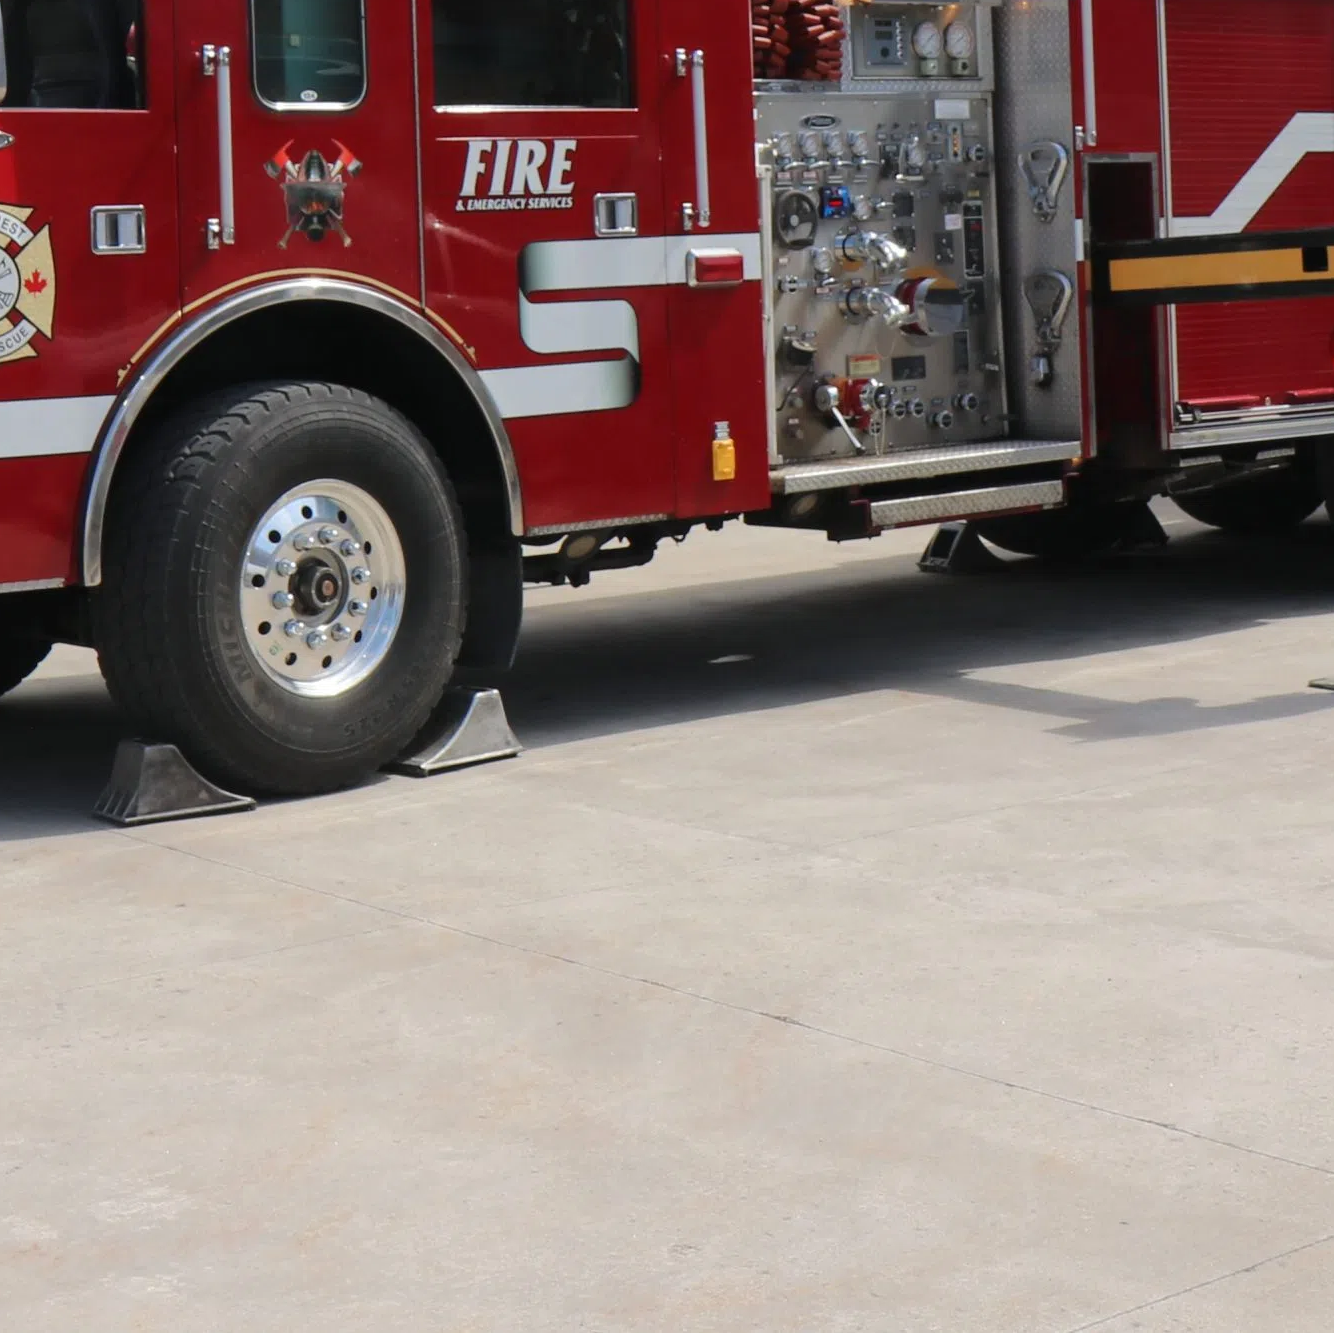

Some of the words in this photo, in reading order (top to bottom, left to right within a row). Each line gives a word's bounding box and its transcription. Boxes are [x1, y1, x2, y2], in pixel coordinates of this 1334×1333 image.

[459, 139, 578, 197] FIRE
[455, 199, 465, 211] &
[467, 197, 526, 211] EMERGENCY
[528, 196, 573, 209] SERVICES
